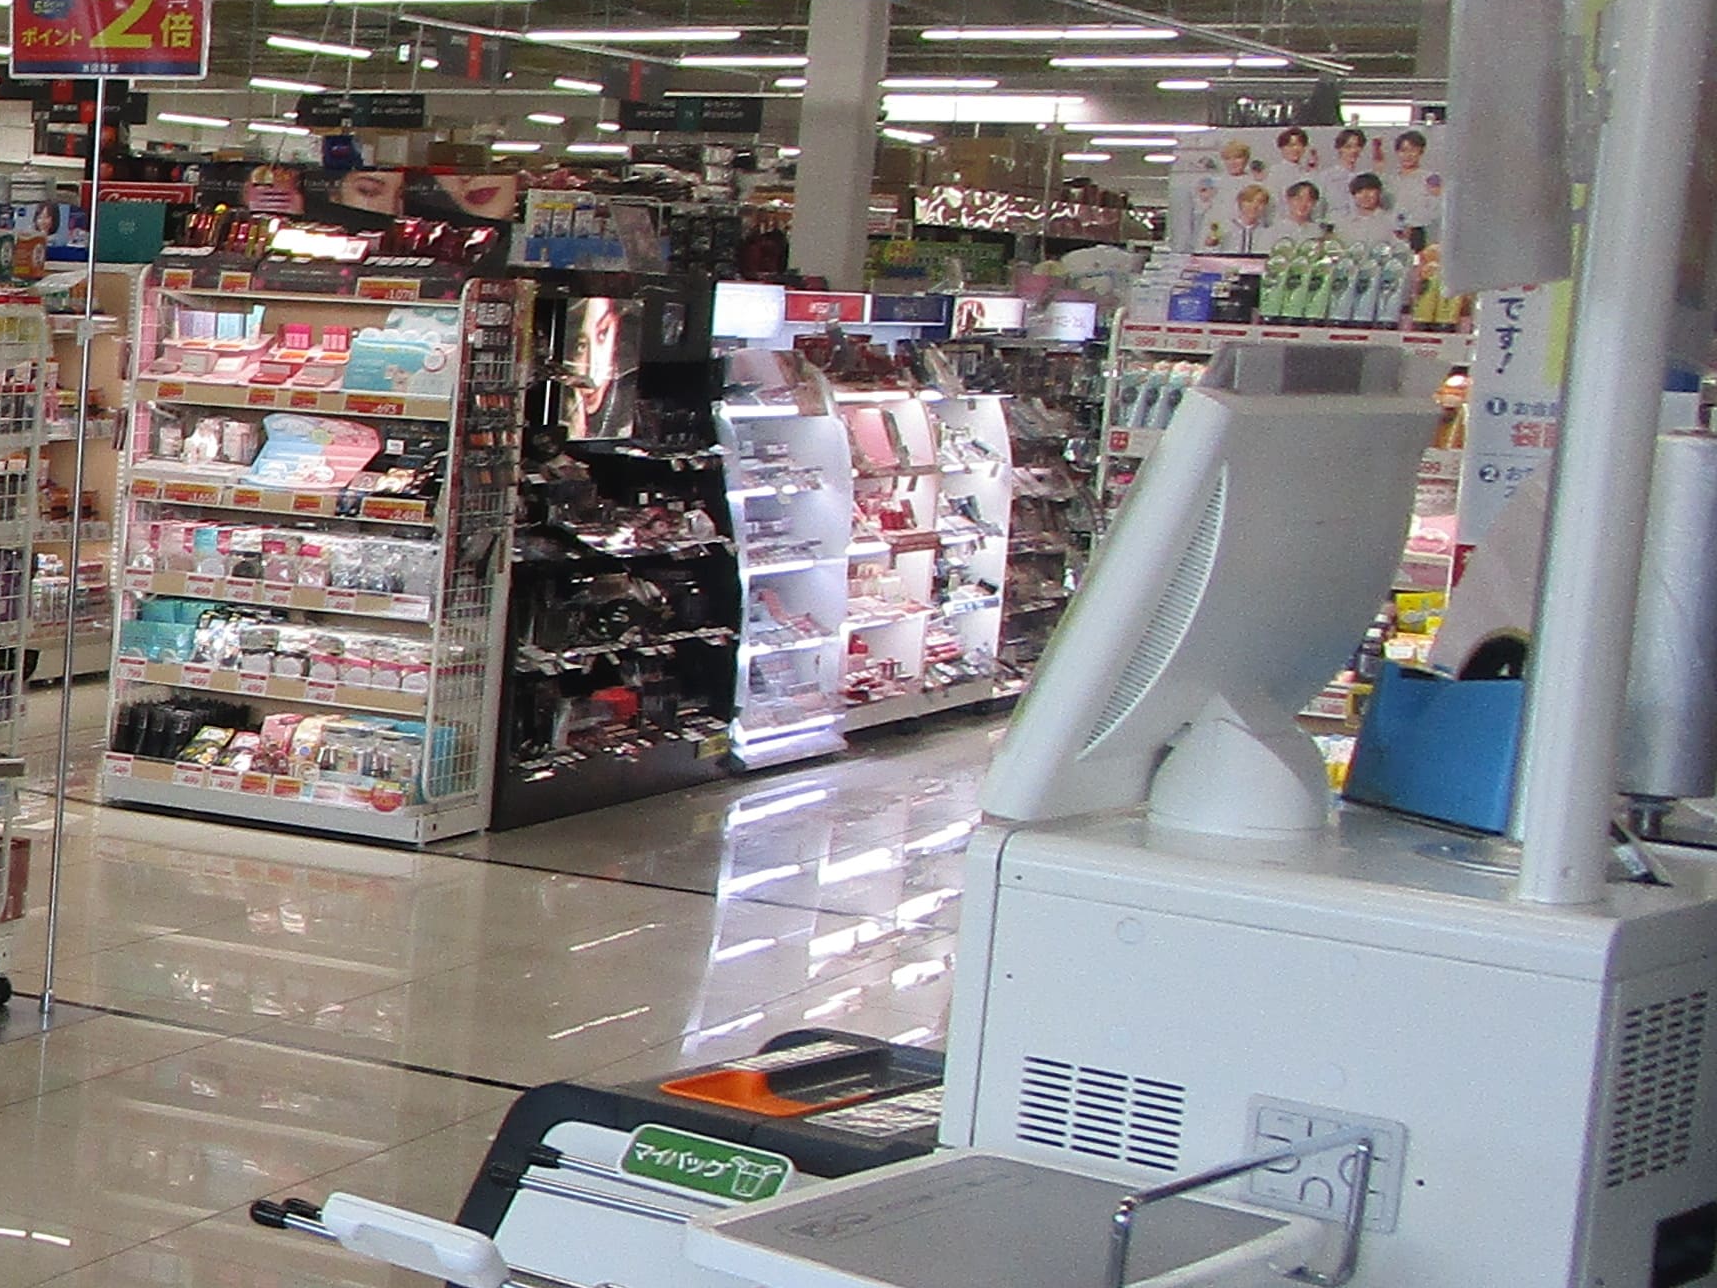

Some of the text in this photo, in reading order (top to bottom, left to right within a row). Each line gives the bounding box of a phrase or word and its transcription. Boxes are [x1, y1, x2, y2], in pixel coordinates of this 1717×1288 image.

[21, 27, 83, 47] ポイント
[634, 1142, 733, 1179] マイバッグ
